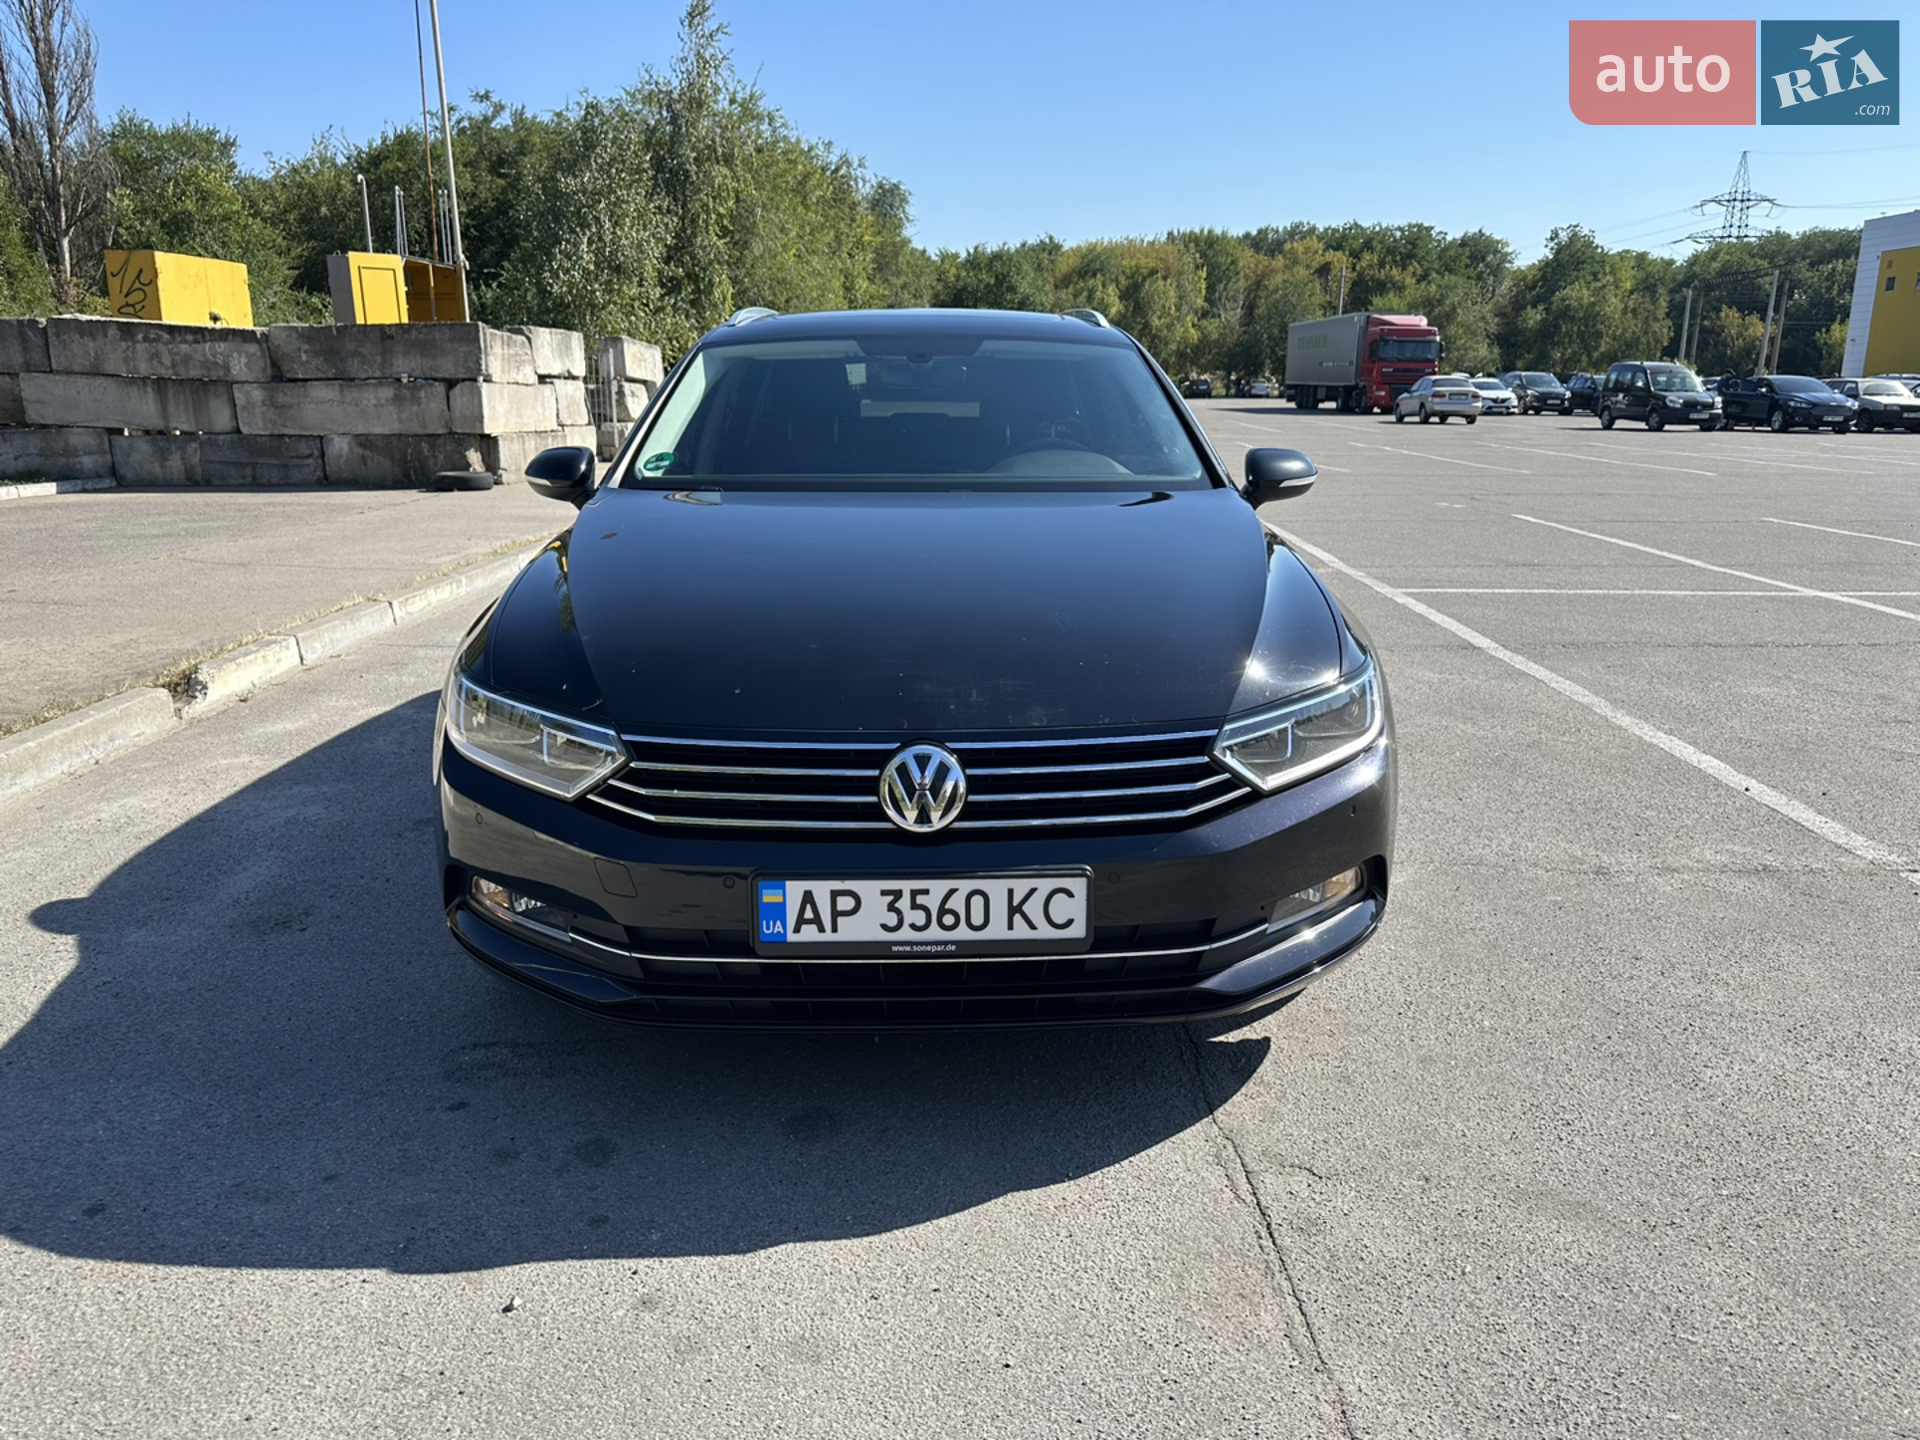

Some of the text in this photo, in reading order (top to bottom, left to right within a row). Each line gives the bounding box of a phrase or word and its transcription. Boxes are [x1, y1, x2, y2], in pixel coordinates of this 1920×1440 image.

[880, 745, 967, 833] VW
[762, 919, 785, 934] UA
[792, 886, 1076, 935] AP 3560 KC
[890, 943, 957, 953] www.sonepar.de
